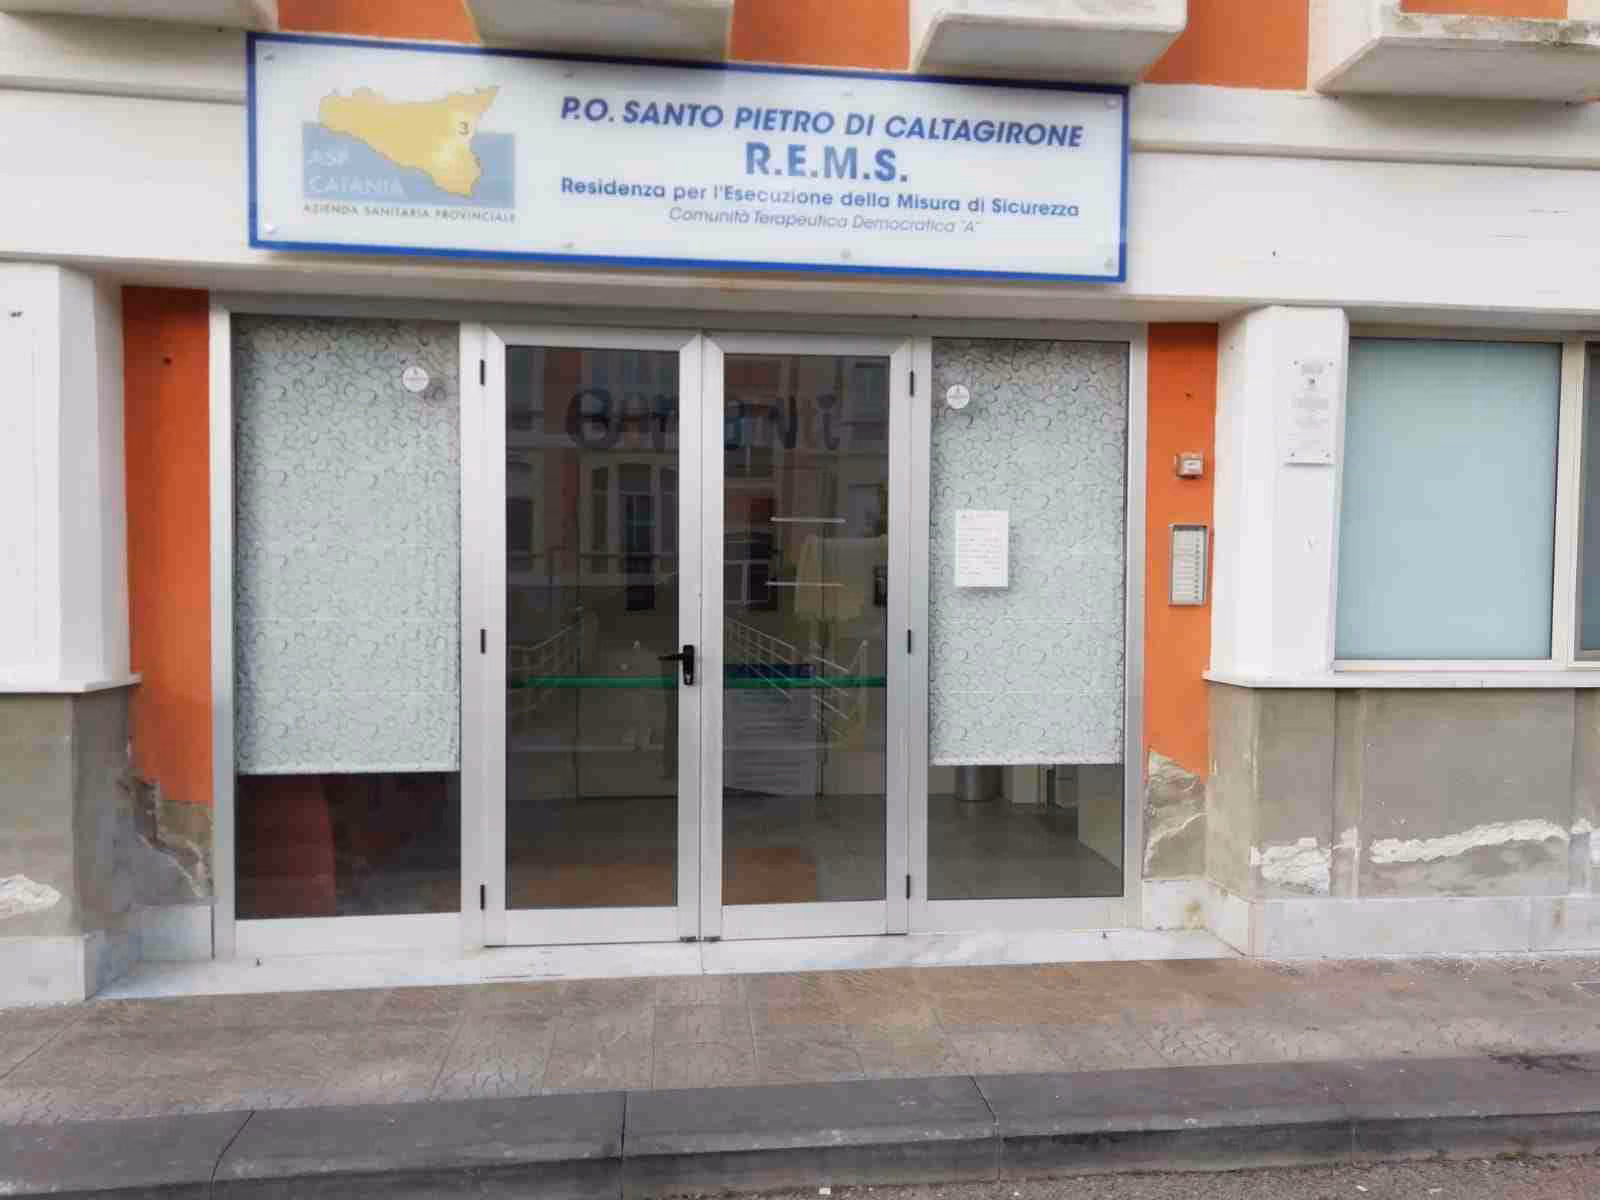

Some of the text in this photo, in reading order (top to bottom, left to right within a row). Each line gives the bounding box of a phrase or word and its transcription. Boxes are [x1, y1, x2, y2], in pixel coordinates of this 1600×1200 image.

[458, 121, 470, 135] 3
[561, 96, 1084, 148] P.O. SANTO PIETRO DI CALTAGIRONE
[745, 142, 908, 182] R.E.M.S.
[303, 201, 516, 223] AZIENDA SANITARIA PROVINCIALE
[561, 177, 1080, 217] Residenza per l'Esecuzione della Misura di Sicurezza
[669, 206, 750, 225] Comunità
[754, 208, 848, 229] Terapeutica
[852, 214, 956, 233] Democratica
